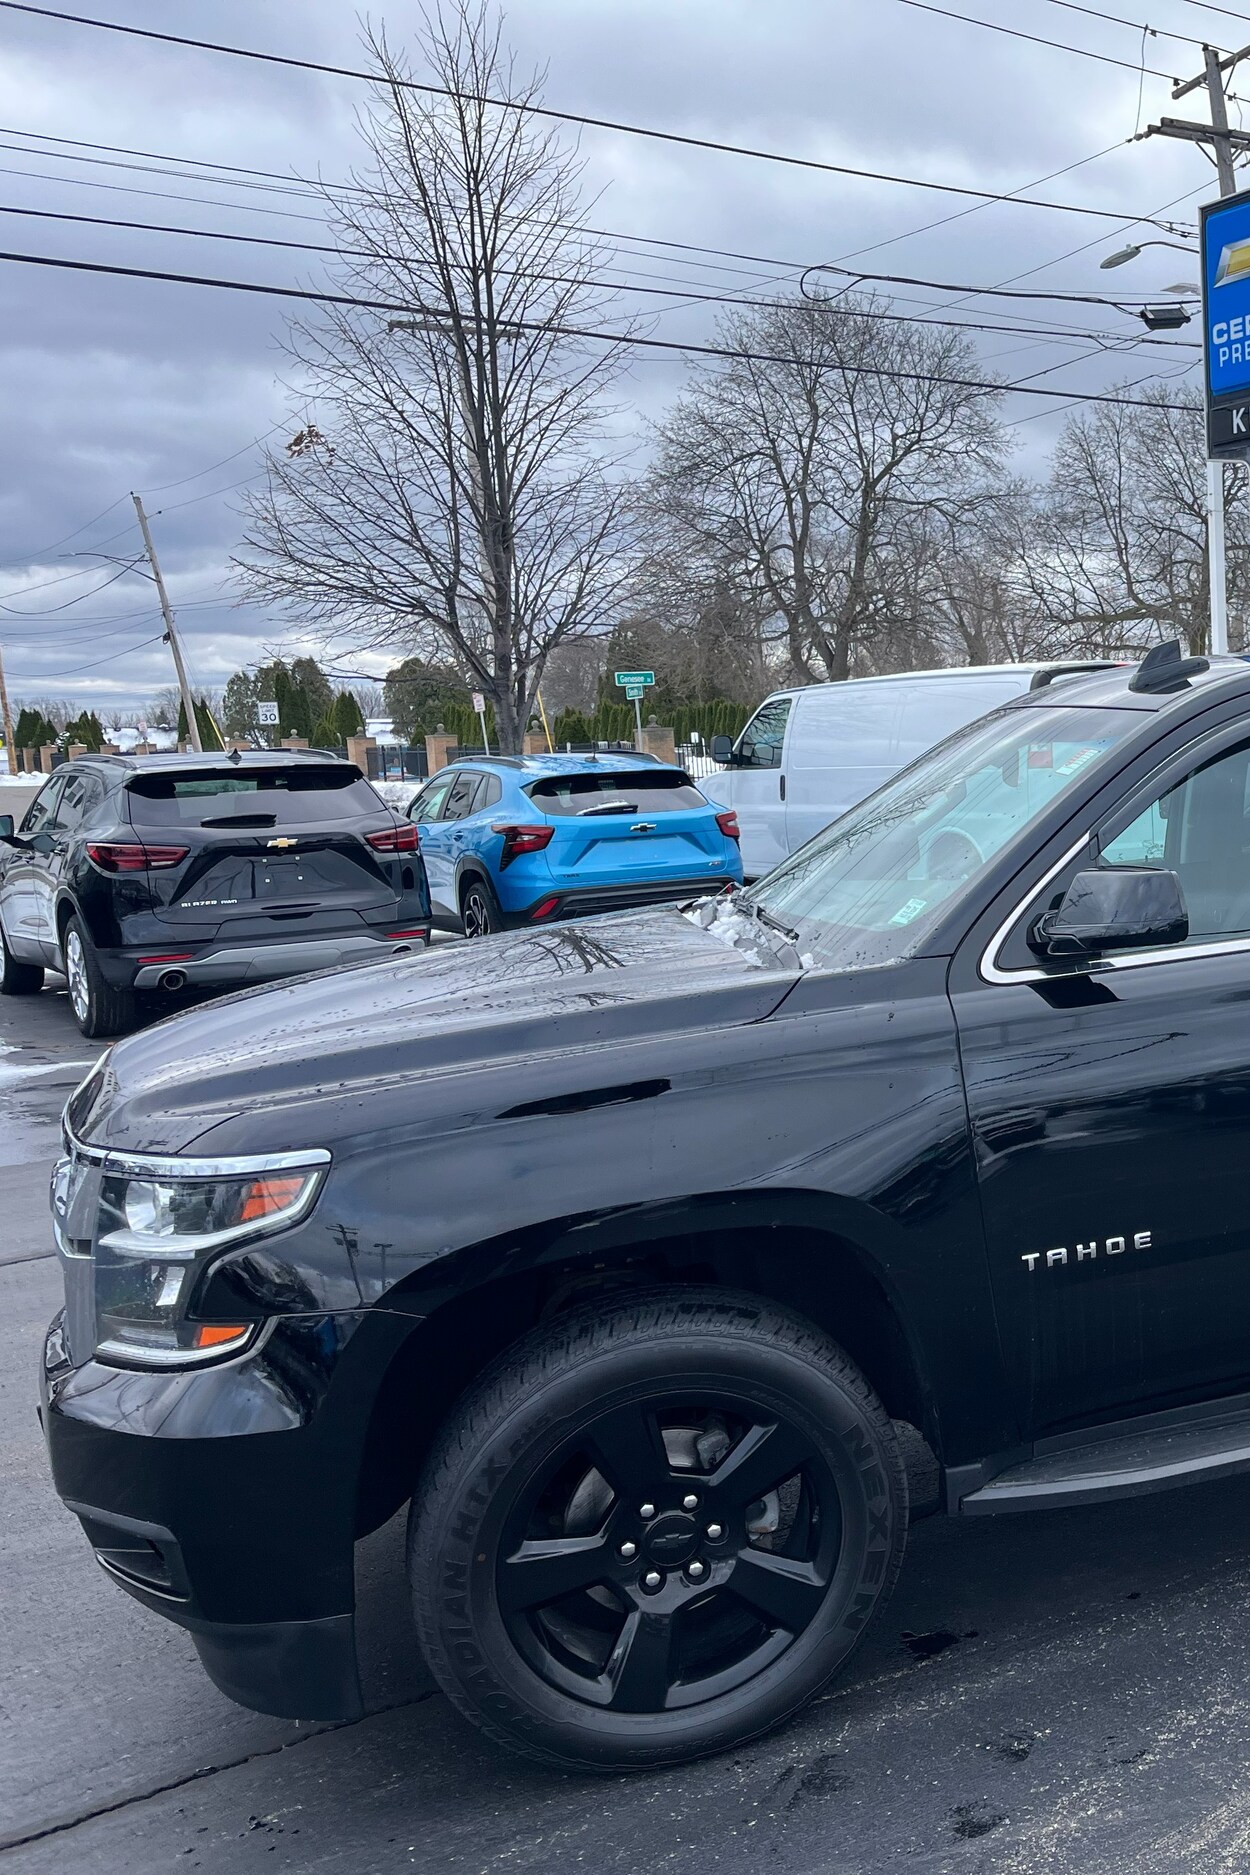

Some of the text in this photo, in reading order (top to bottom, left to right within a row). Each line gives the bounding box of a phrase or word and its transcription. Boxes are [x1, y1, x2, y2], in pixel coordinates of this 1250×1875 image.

[261, 713, 277, 722] 30
[1021, 1231, 1152, 1272] TAHOE
[839, 1421, 890, 1632] NEXEN
